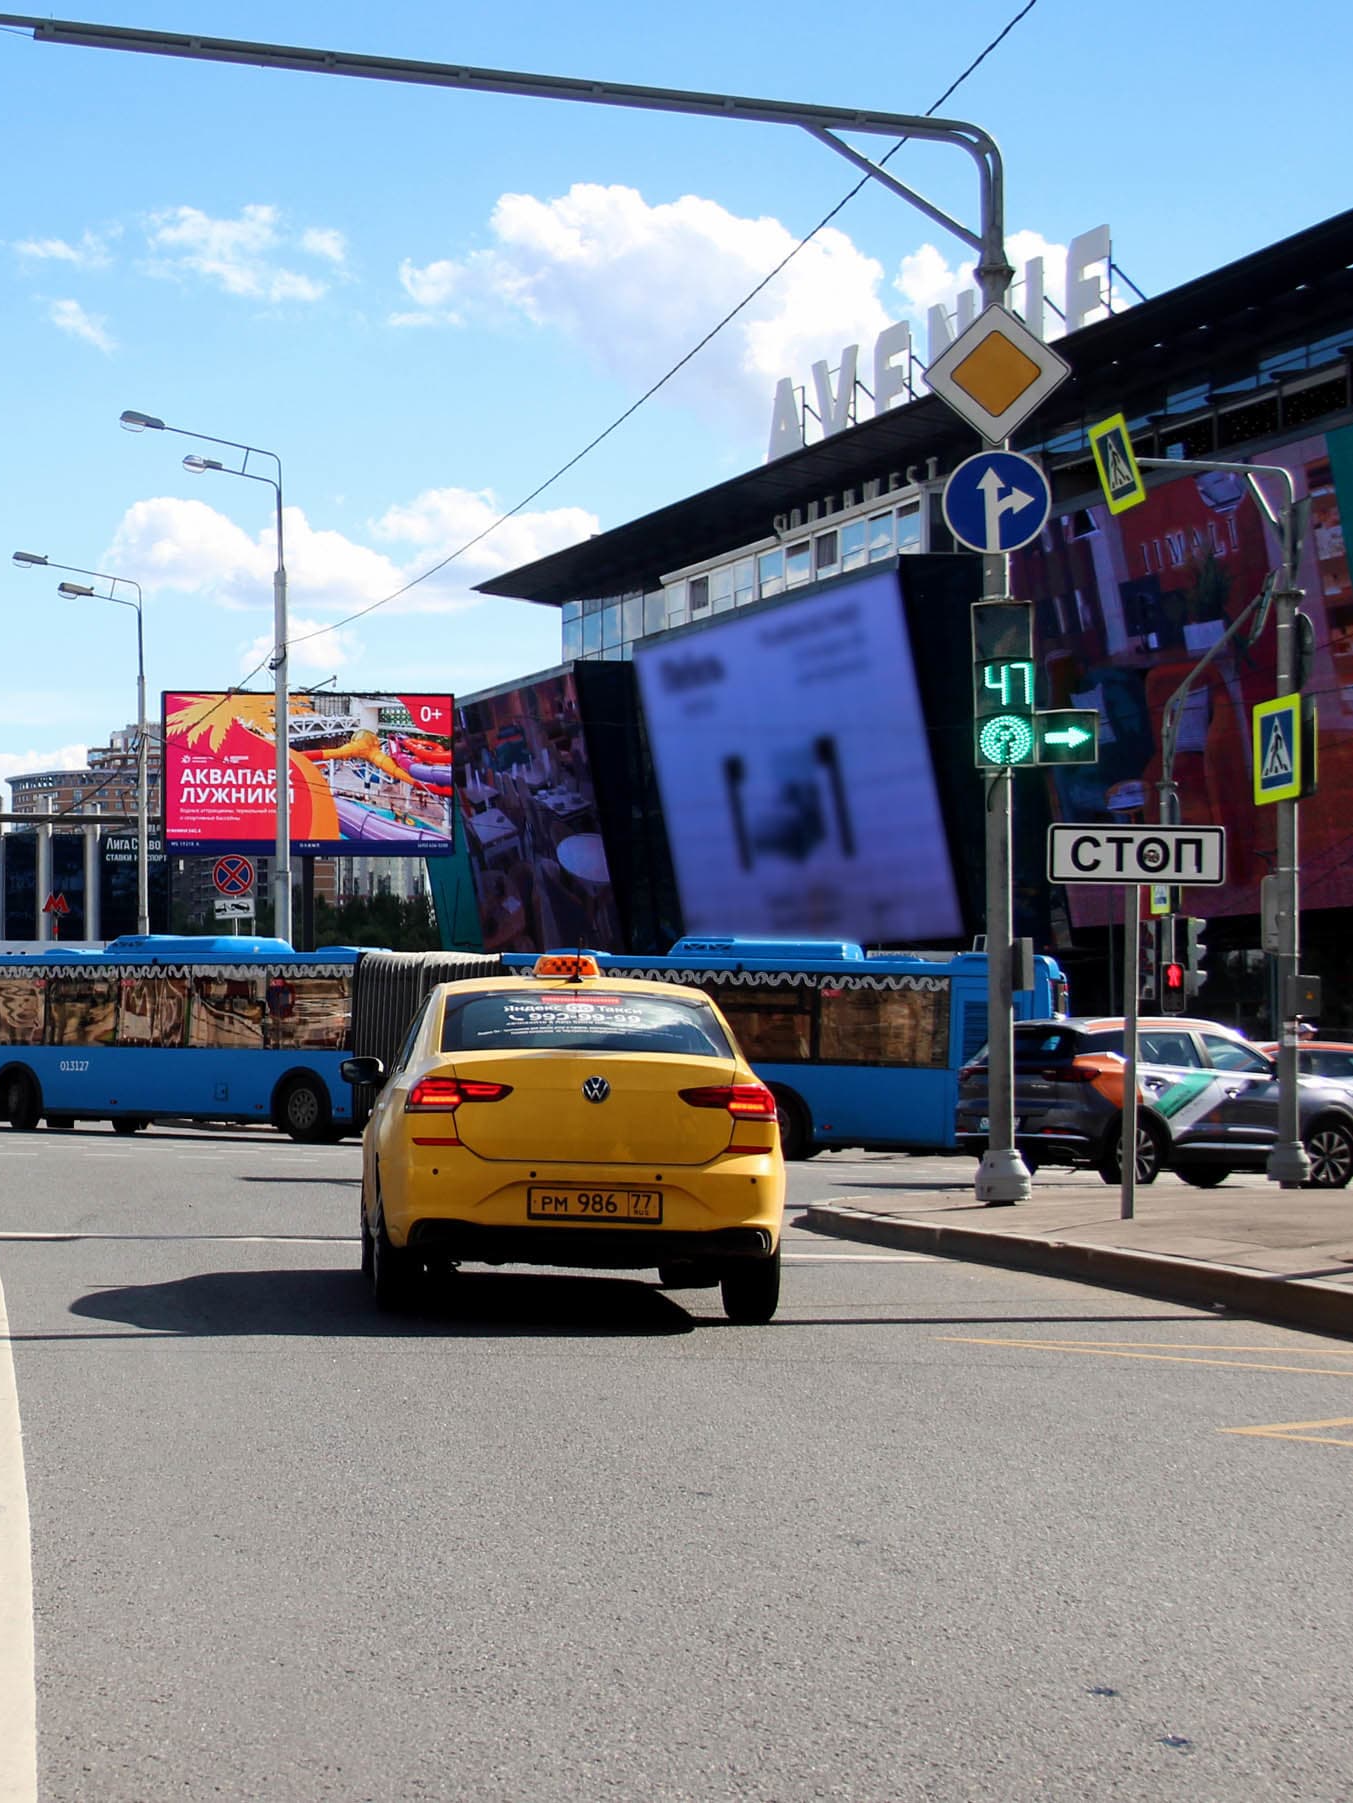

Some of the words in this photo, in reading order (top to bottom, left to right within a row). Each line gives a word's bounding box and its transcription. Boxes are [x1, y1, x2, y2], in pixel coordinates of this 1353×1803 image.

[984, 663, 1033, 705] 47
[420, 706, 443, 722] 0+
[1071, 835, 1203, 873] СТОП
[60, 1060, 88, 1071] 013127
[577, 1193, 618, 1213] 986
[631, 1193, 652, 1208] 77
